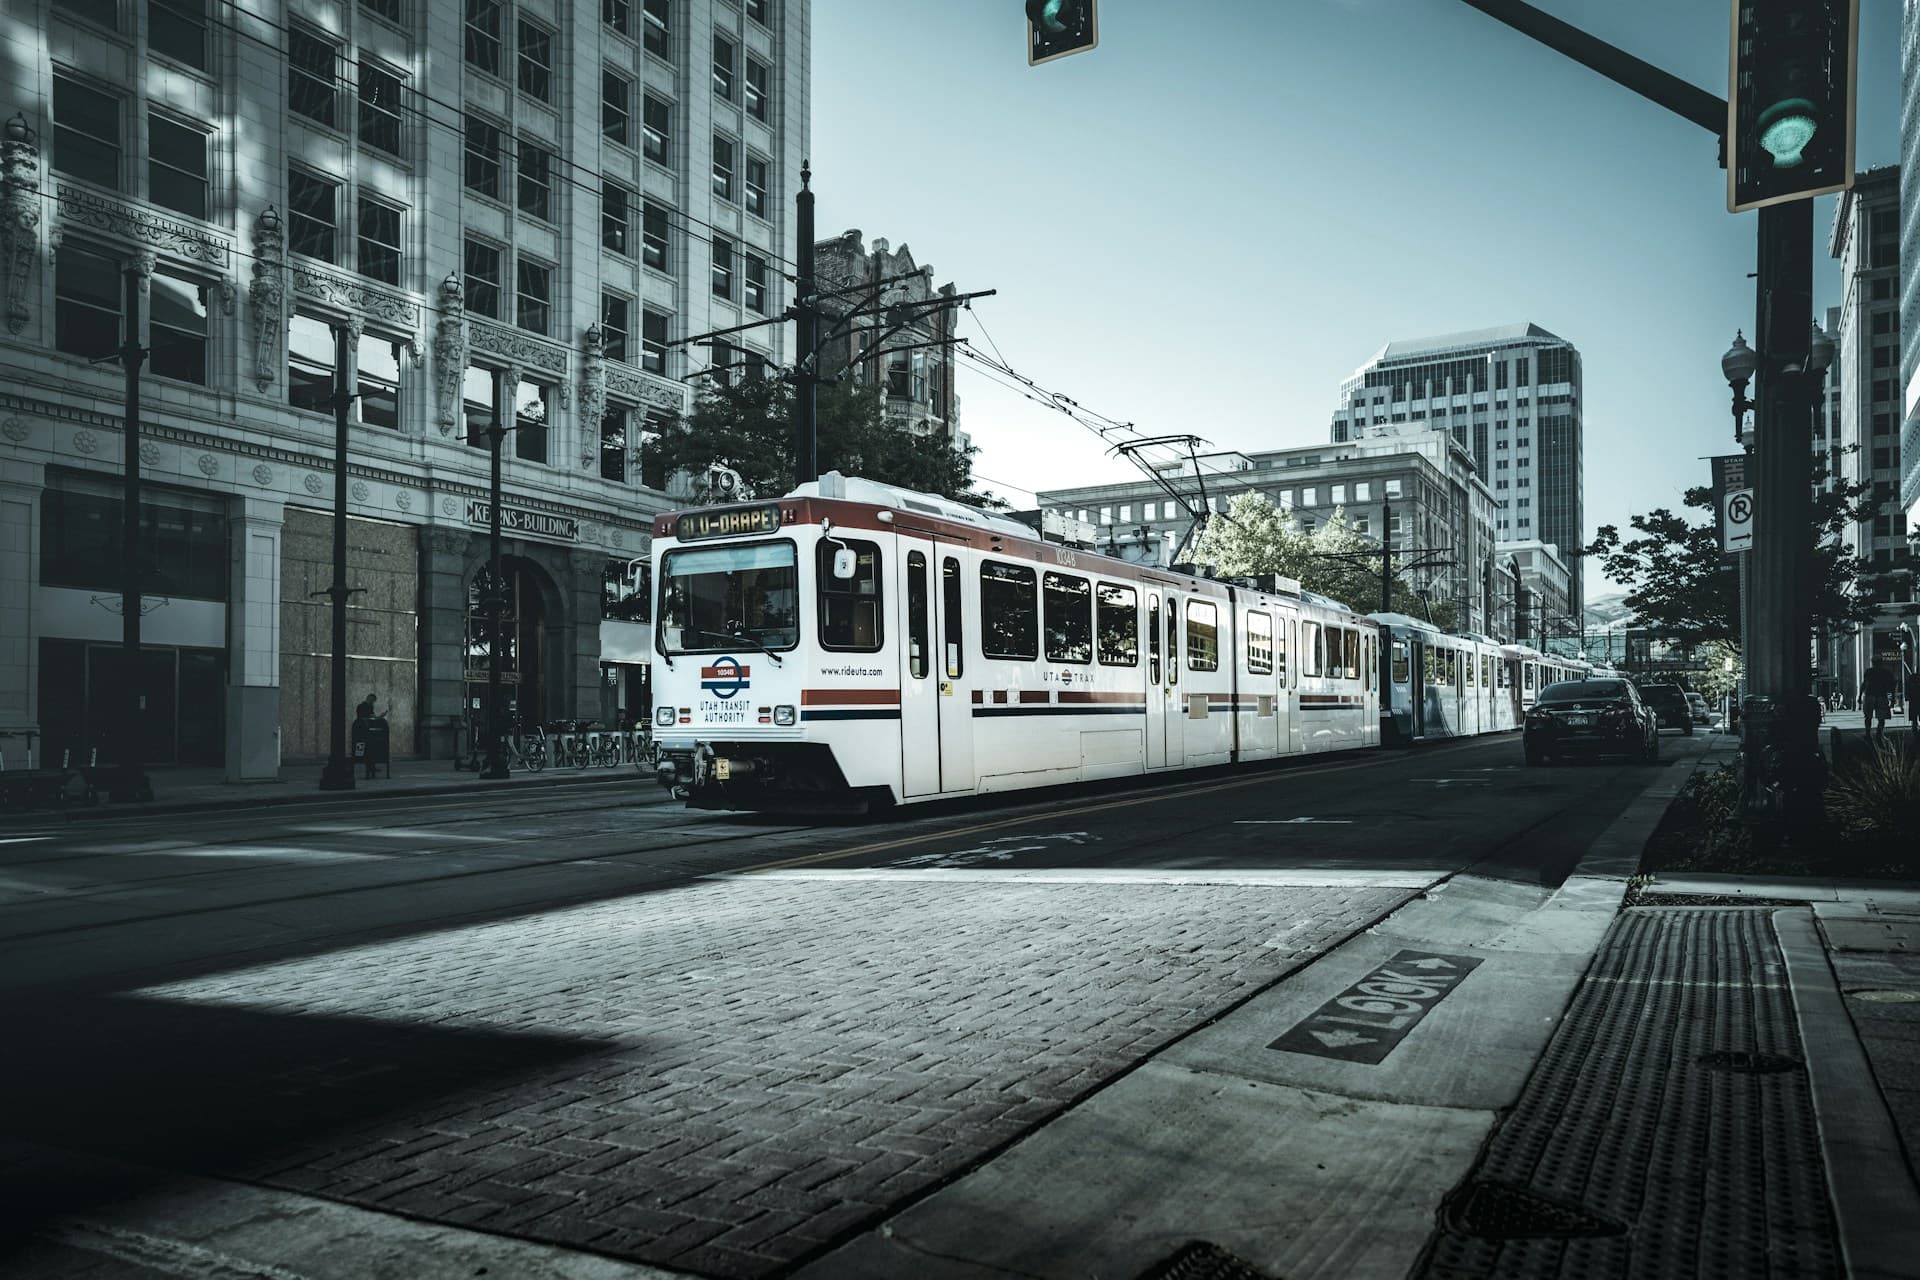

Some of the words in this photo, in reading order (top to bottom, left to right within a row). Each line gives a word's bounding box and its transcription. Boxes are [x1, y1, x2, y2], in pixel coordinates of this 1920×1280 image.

[820, 665, 883, 677] www.rideuta.com
[1043, 671, 1060, 681] UTA
[1074, 673, 1095, 683] TRAX
[700, 700, 718, 711] UTAH
[720, 700, 750, 711] TRANSIT
[705, 712, 745, 722] AUTHORITY
[1314, 969, 1458, 1029] LOOK
